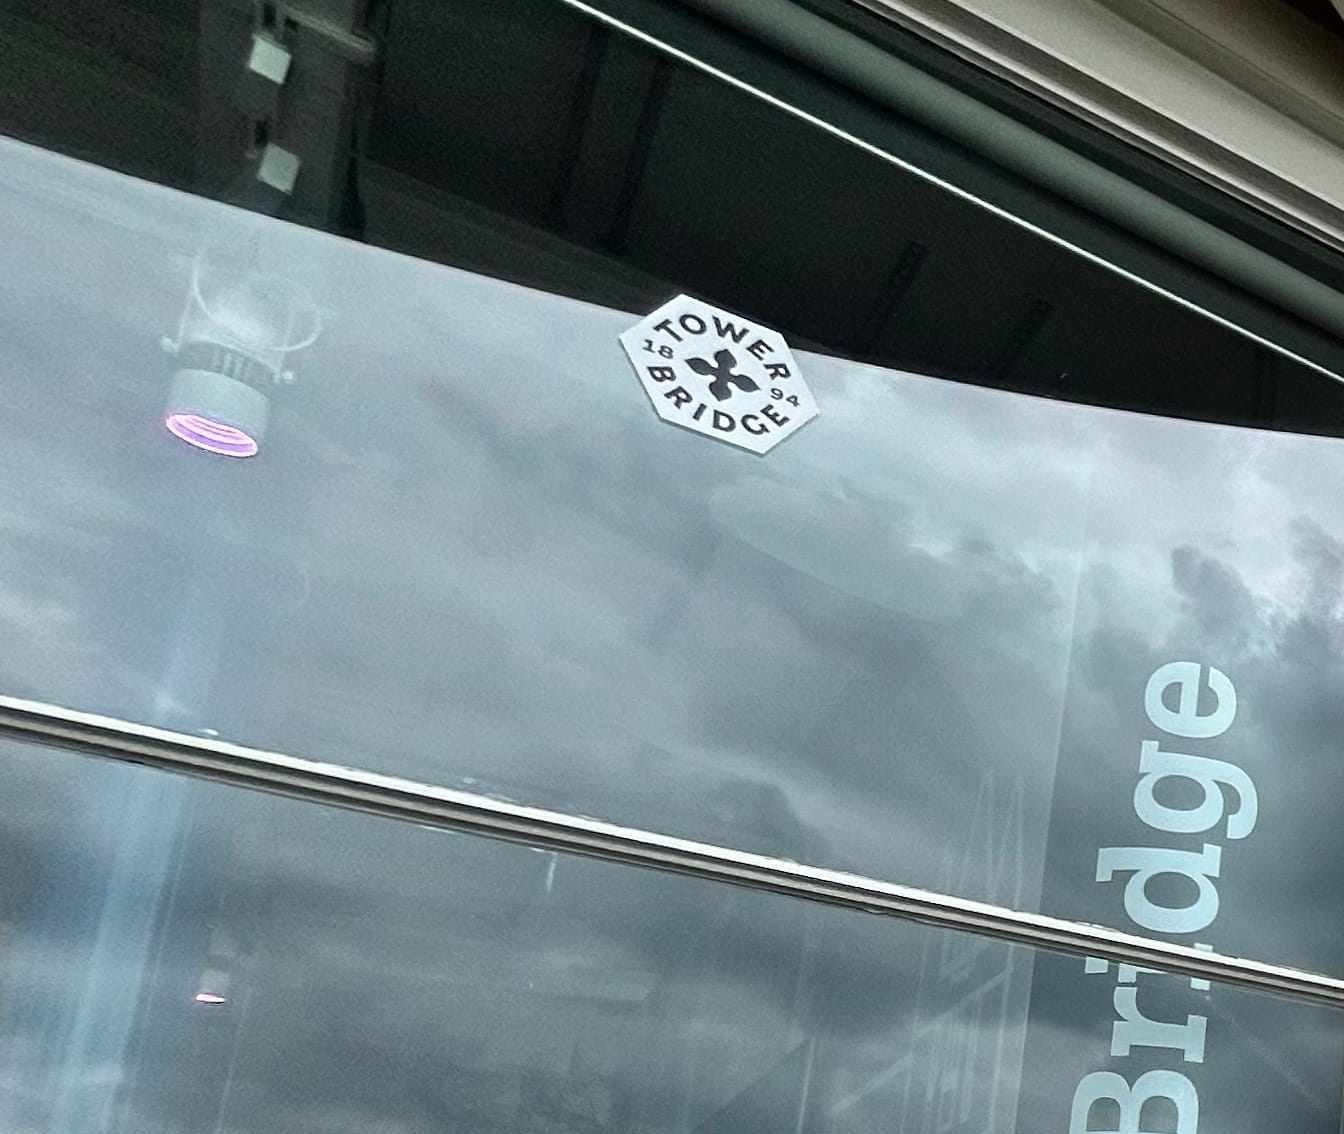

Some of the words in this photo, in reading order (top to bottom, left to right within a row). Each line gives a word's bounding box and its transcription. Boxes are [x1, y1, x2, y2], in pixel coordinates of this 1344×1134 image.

[642, 339, 674, 360] 18
[653, 313, 792, 381] TOWER
[646, 365, 791, 436] BRIDGE
[769, 387, 801, 408] 94
